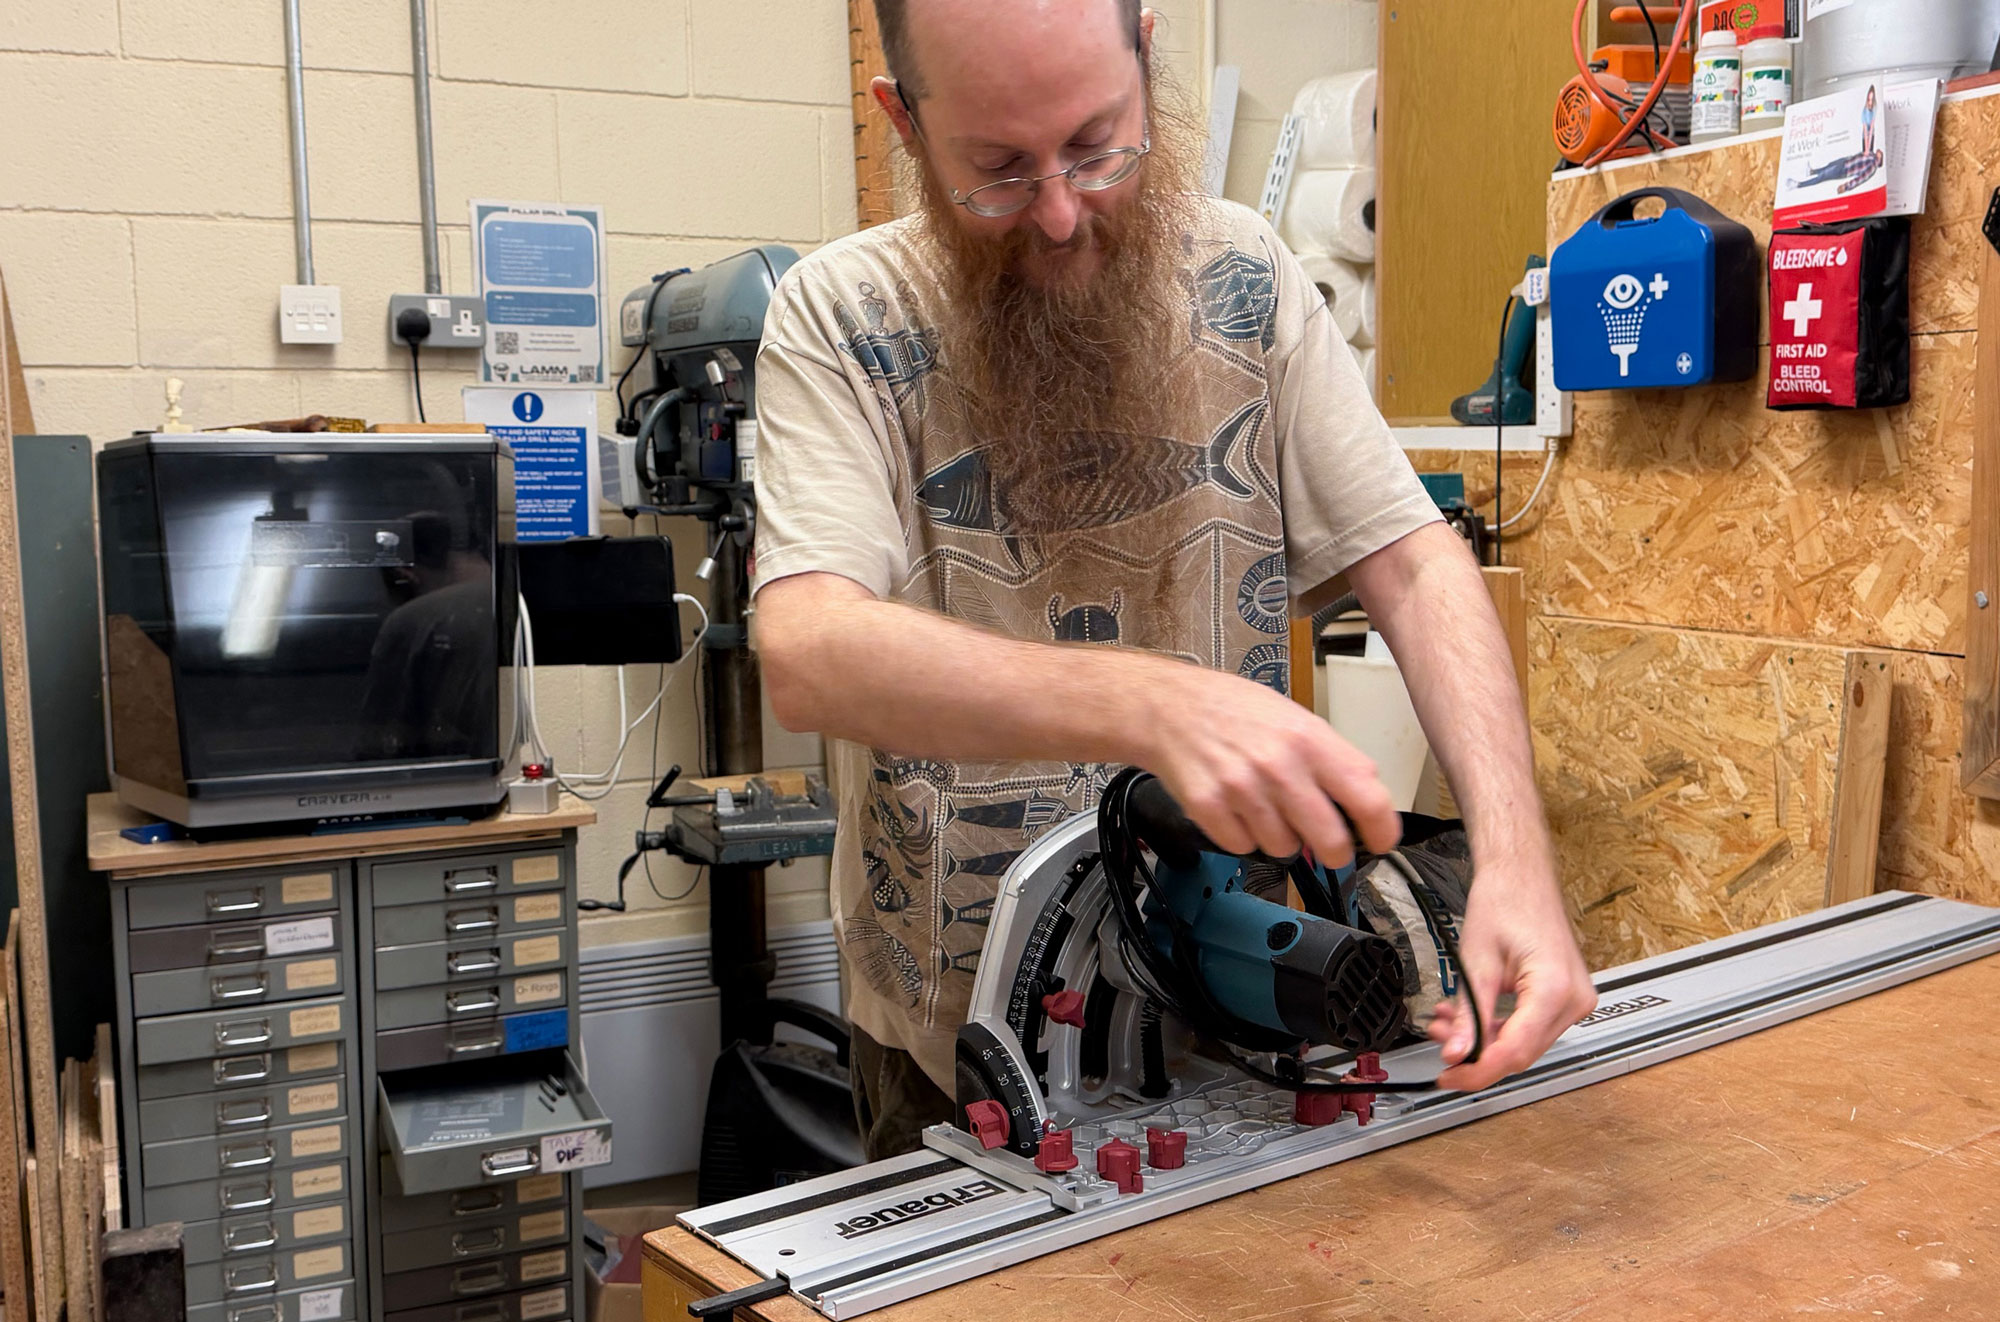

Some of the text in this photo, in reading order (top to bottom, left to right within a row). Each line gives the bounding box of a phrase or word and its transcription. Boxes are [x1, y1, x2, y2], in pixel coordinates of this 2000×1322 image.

[1773, 247, 1837, 270] BLEEDSAVE
[1776, 344, 1827, 358] FIRST AID
[520, 365, 568, 375] LAMM
[1780, 365, 1820, 378] BLEED
[1774, 379, 1832, 394] CONTROL
[298, 793, 370, 807] CARVERA
[764, 840, 808, 855] LEAVE
[1044, 910, 1053, 918] 5
[1037, 922, 1047, 932] 10
[1031, 935, 1041, 945] 15
[1027, 947, 1037, 958] 20
[1022, 960, 1032, 971] 25
[1018, 973, 1028, 984] 30
[1015, 985, 1025, 997] 35
[1012, 998, 1021, 1010] 40
[1009, 1011, 1019, 1023] 45
[982, 1048, 994, 1061] 45
[997, 1073, 1010, 1086] 30
[290, 1093, 337, 1105] Clamps
[1011, 1105, 1022, 1117] 15
[545, 1136, 572, 1149] TAP
[1020, 1141, 1031, 1149] 0
[834, 1180, 1008, 1238] Erbauer
